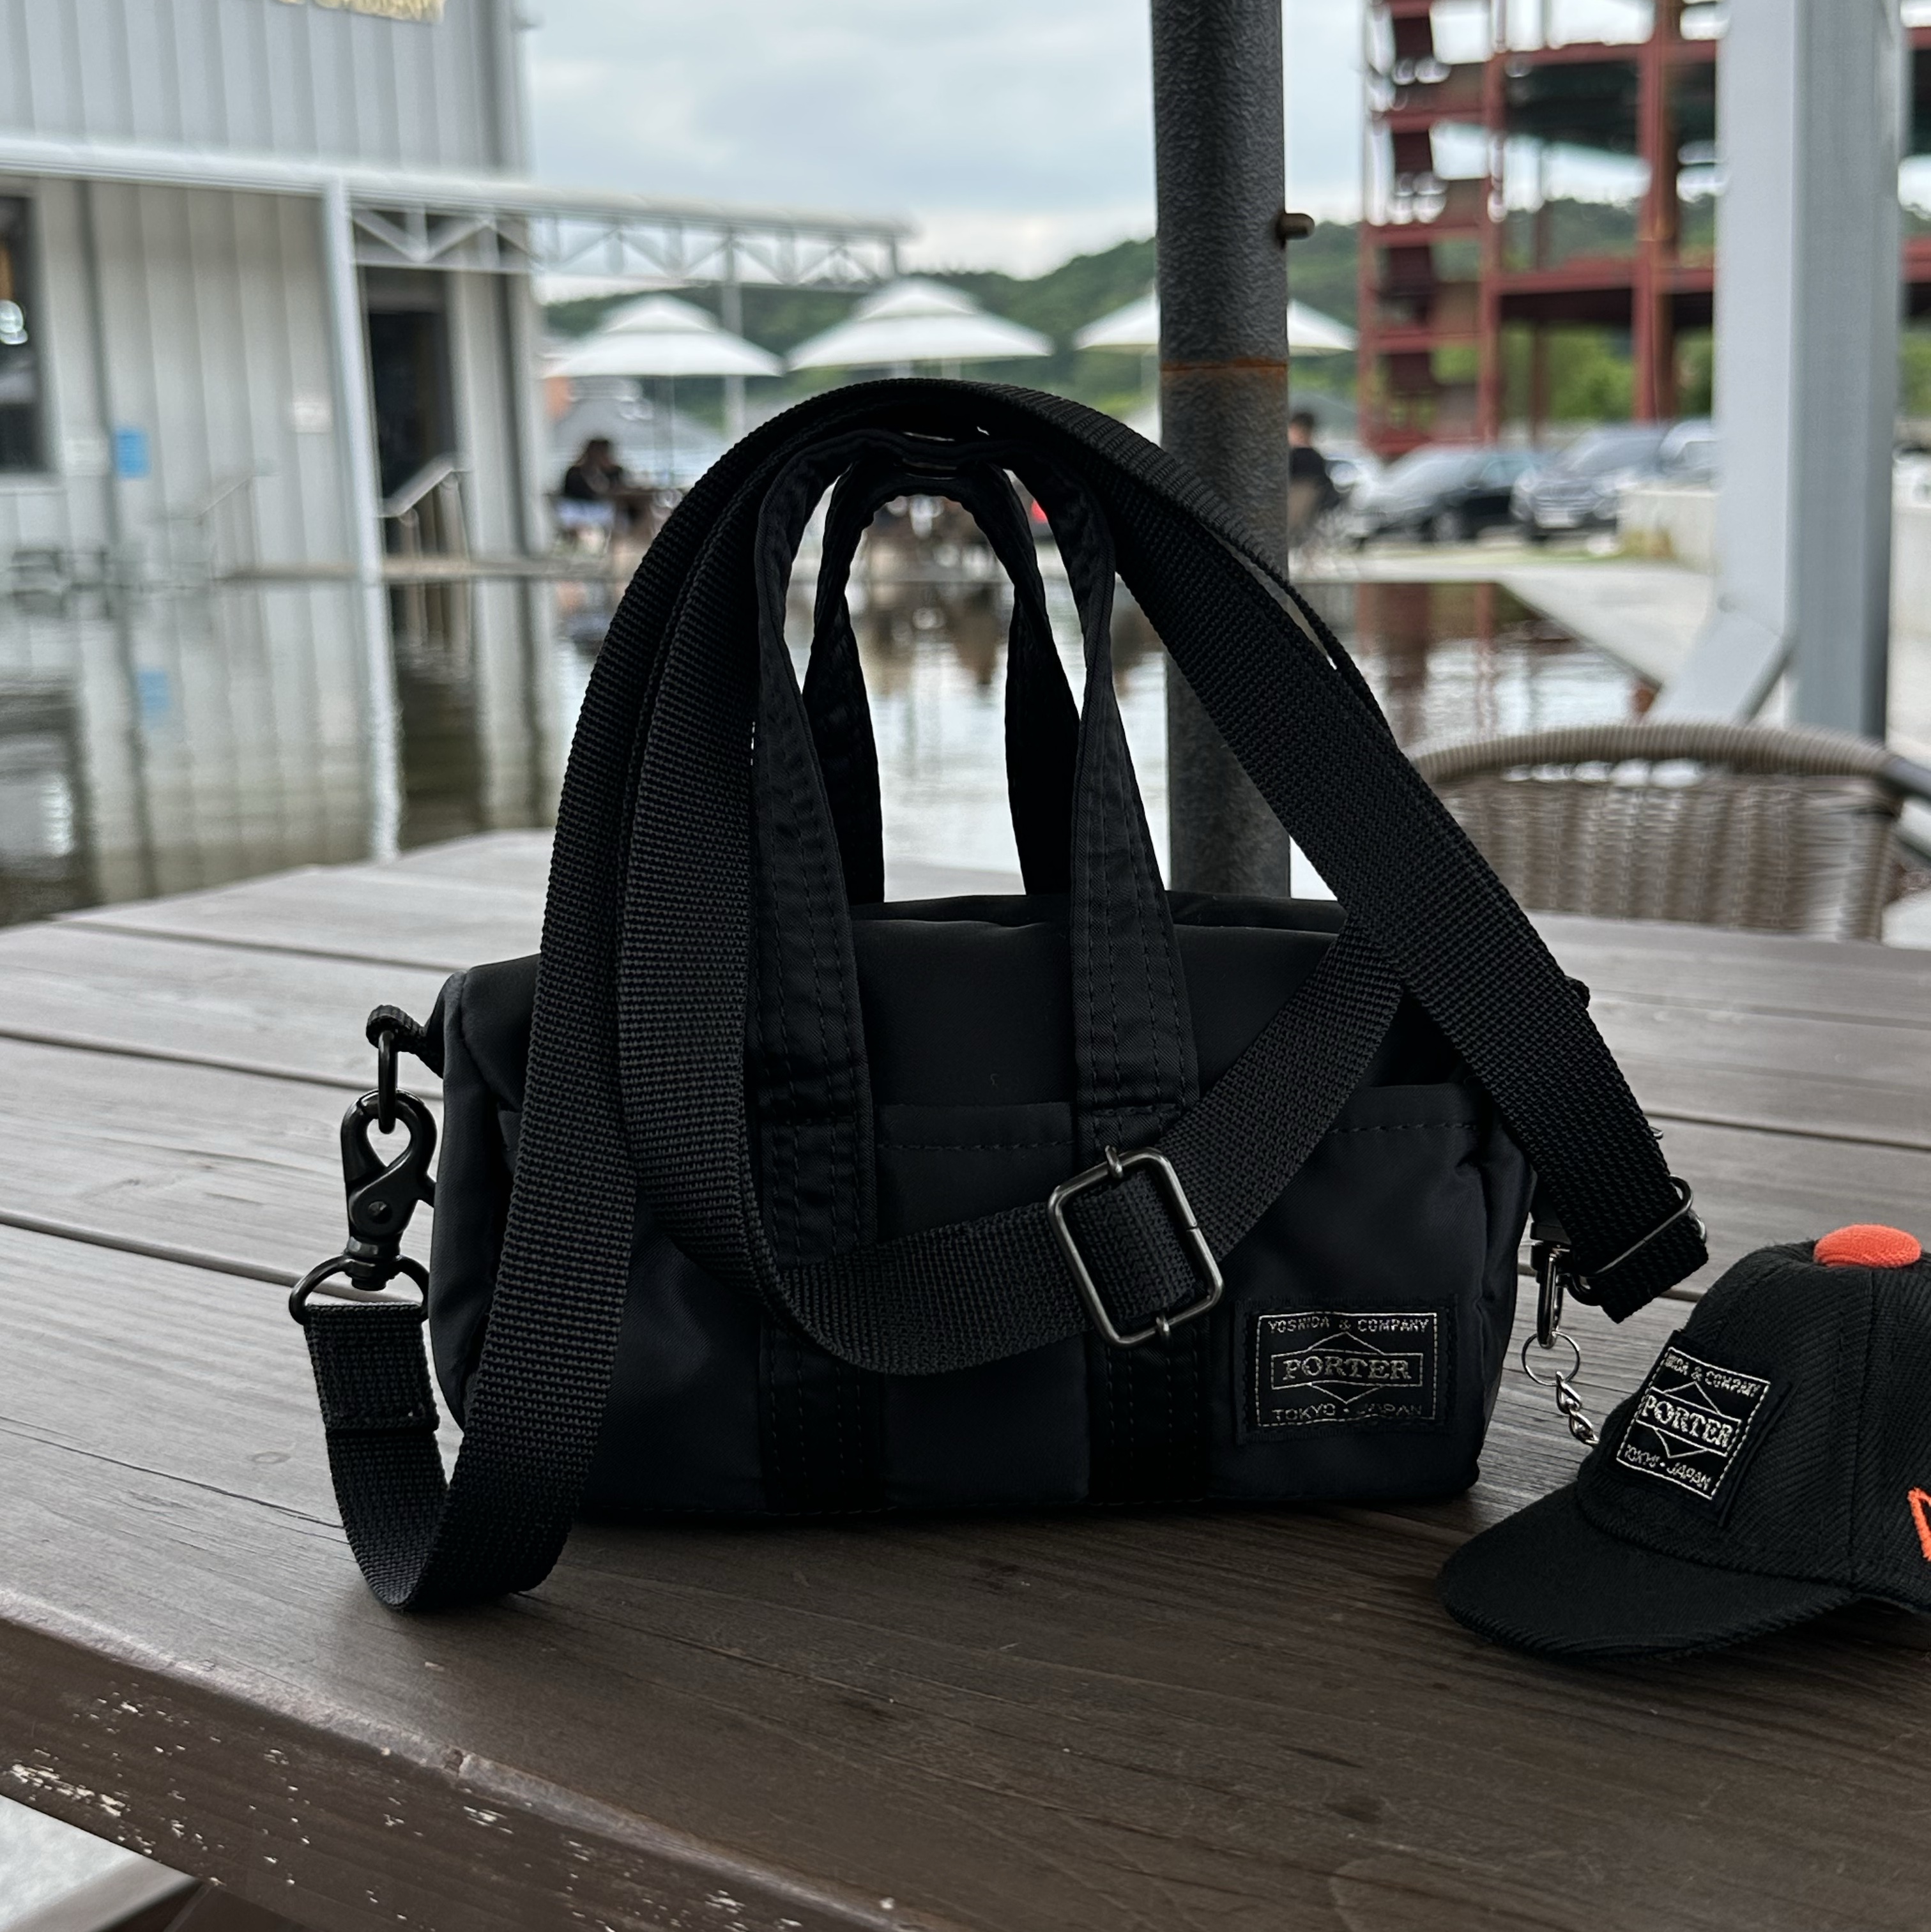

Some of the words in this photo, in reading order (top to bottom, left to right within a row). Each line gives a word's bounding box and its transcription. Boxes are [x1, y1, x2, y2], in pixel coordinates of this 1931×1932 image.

[1358, 1320, 1429, 1332] COMPANY
[1283, 1356, 1411, 1380] PORTER
[1272, 1404, 1336, 1420] TOKYO
[1642, 1396, 1732, 1447] PORTER
[1667, 1463, 1711, 1490] JAPAN
